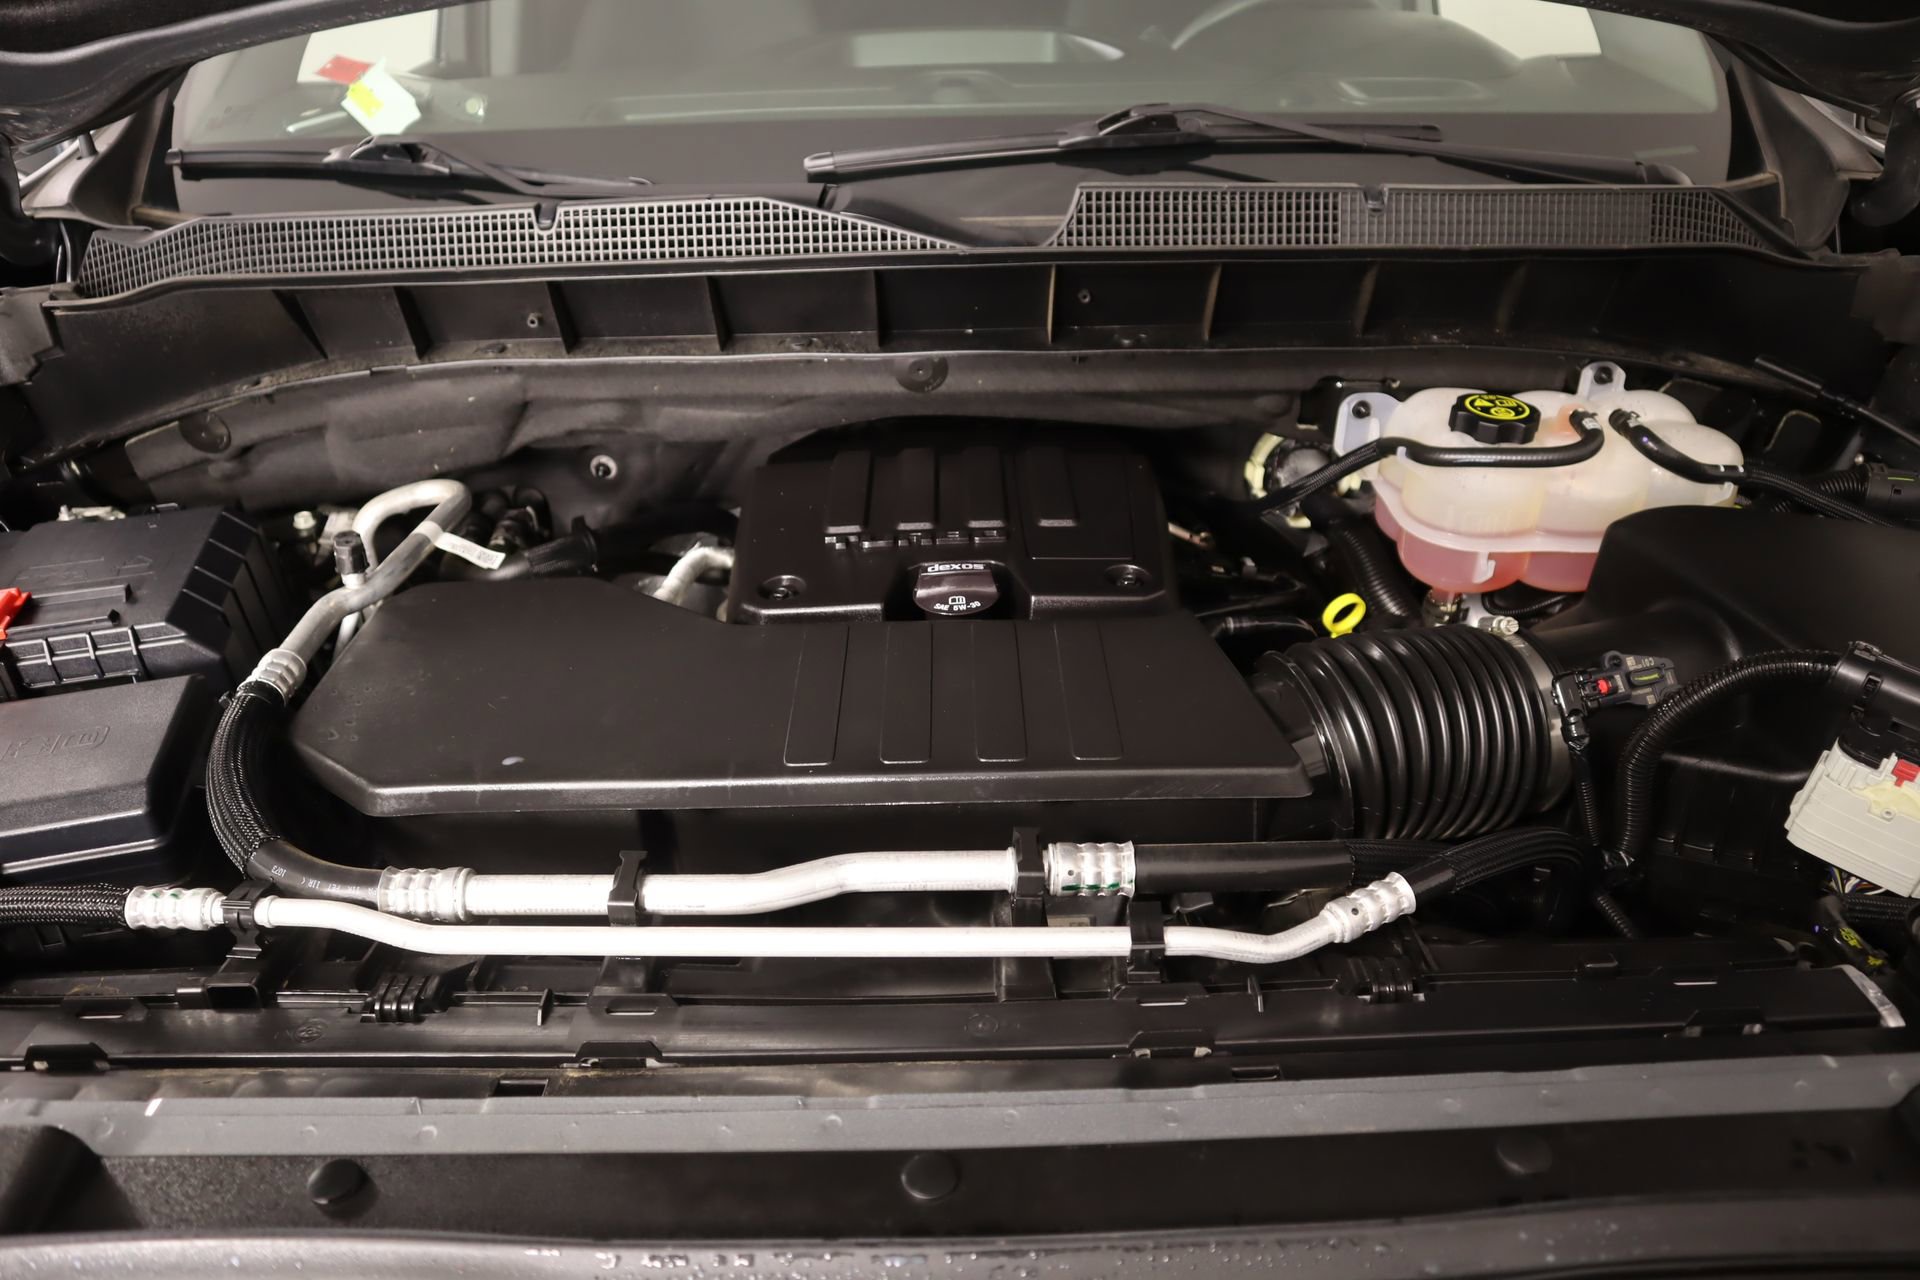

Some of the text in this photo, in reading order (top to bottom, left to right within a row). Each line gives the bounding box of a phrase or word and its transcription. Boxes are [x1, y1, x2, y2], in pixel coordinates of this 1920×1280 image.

[927, 563, 984, 572] dexos
[933, 600, 981, 611] SAE 5W-30
